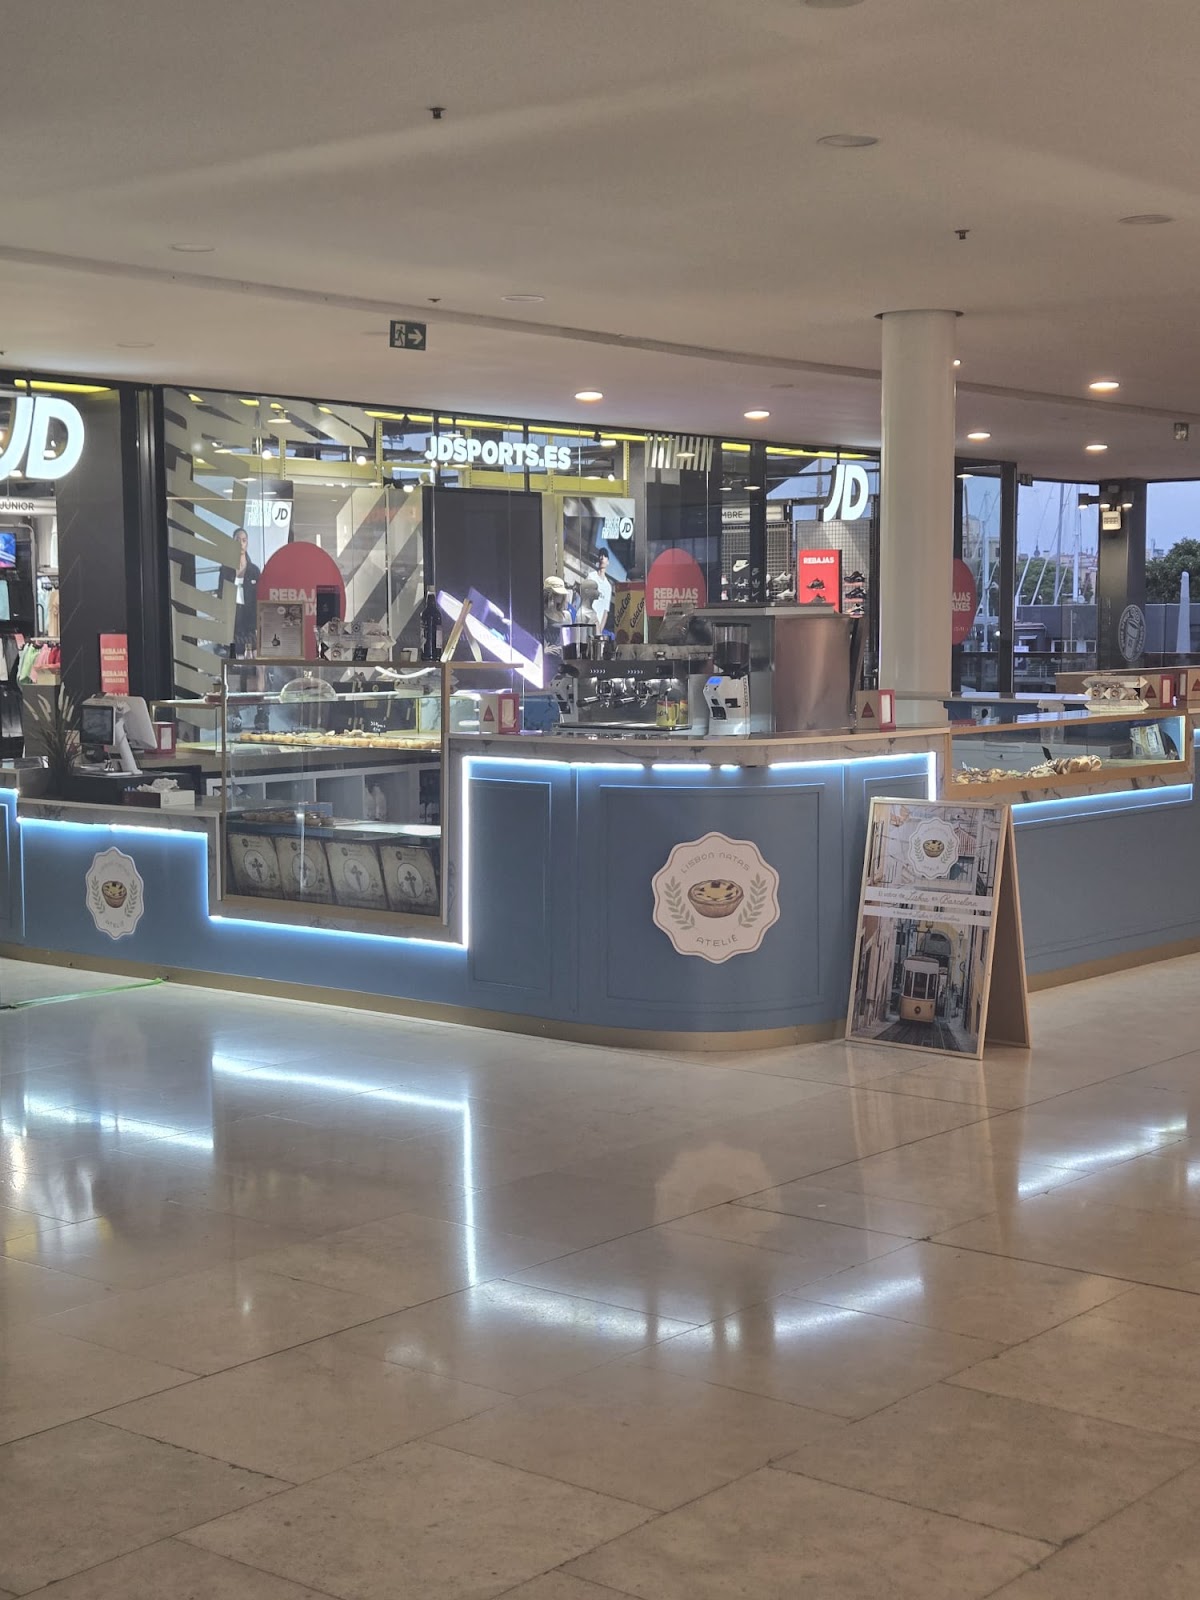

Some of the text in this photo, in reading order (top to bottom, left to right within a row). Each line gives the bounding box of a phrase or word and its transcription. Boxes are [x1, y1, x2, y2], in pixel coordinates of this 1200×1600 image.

[0, 396, 85, 480] JD
[424, 435, 572, 470] JDSPORTS.ES
[823, 464, 869, 522] JD
[721, 510, 743, 519] MBRE
[803, 557, 835, 565] REBAJAS
[269, 588, 316, 601] REBAJ
[653, 587, 699, 600] REBAJAS
[952, 591, 971, 602] AJAS
[680, 851, 751, 874] LISBON NATAS
